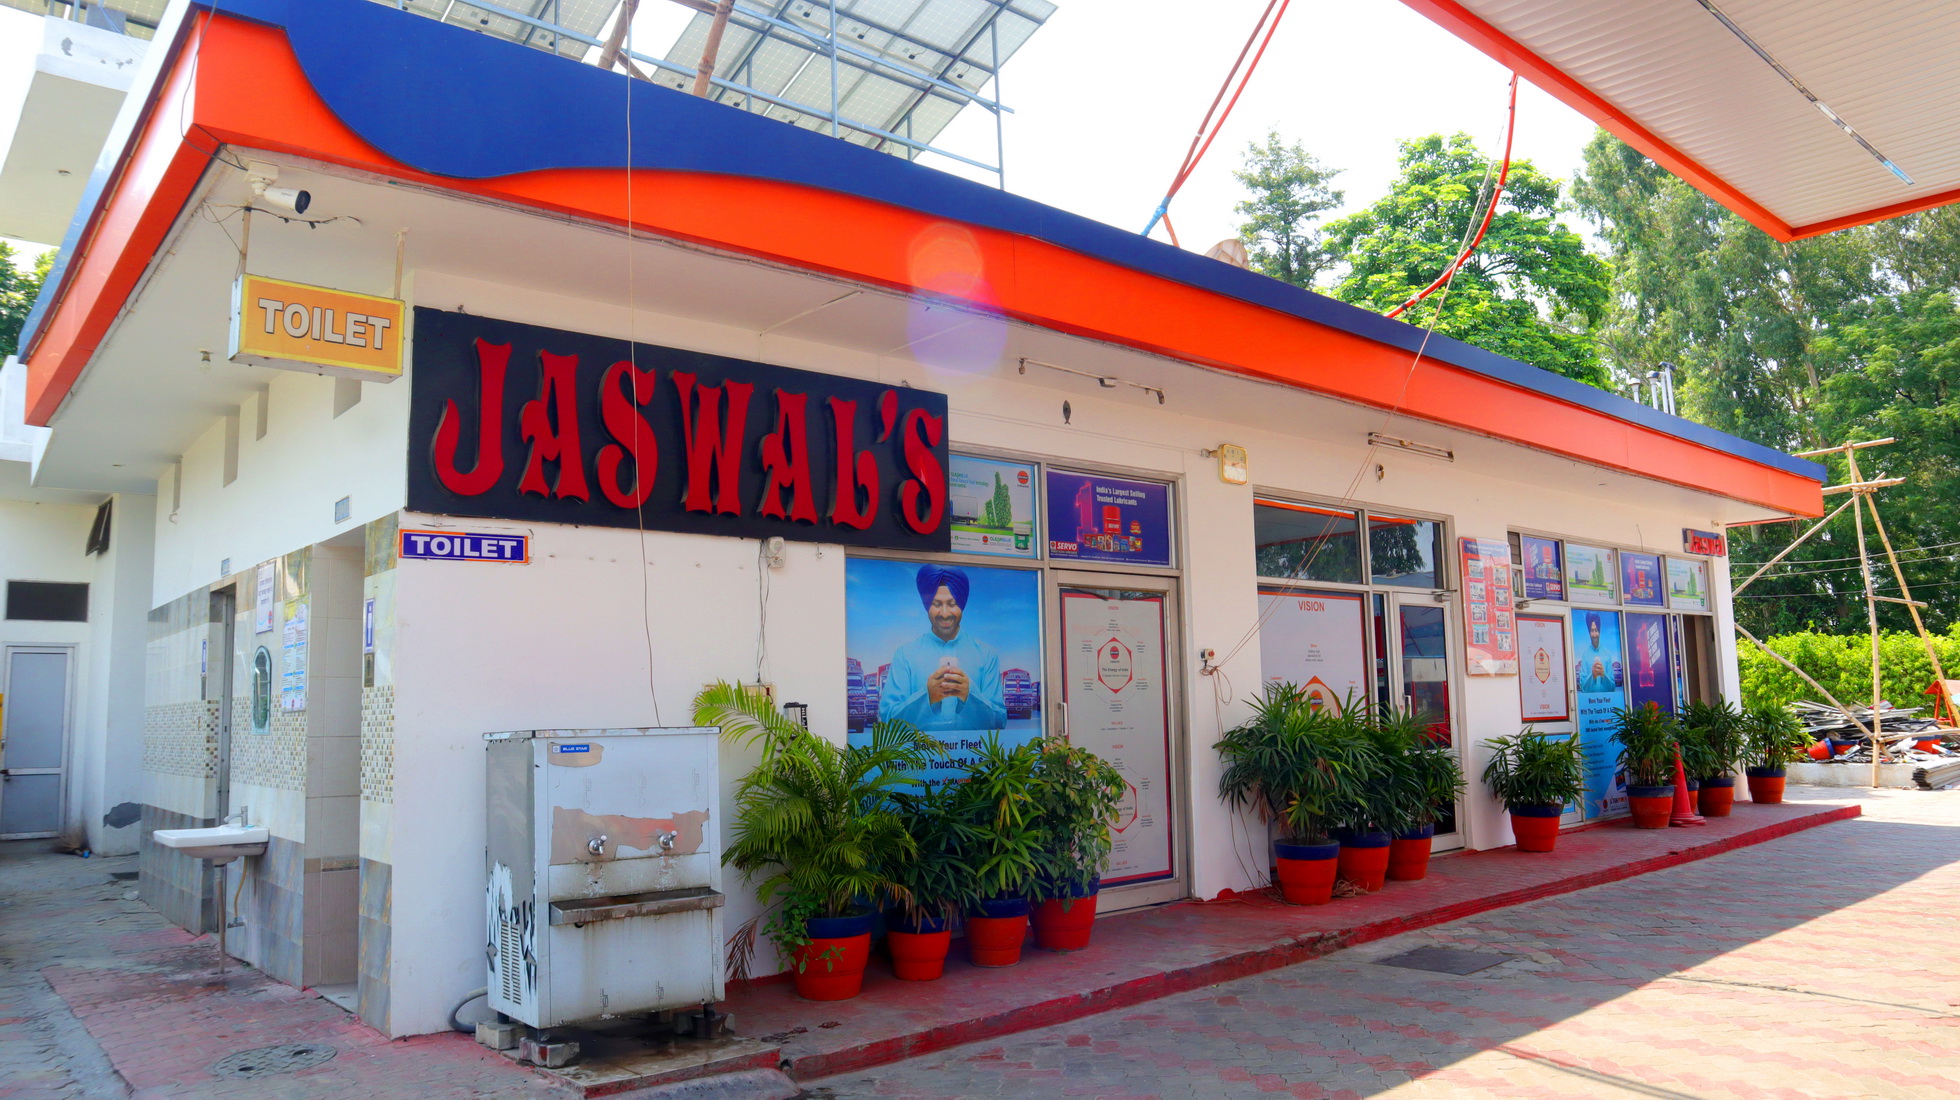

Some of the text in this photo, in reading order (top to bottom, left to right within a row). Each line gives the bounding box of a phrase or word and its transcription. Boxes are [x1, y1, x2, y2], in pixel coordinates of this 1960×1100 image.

[258, 297, 391, 351] TOILET
[431, 336, 946, 535] JASWAL'S
[410, 534, 524, 559] TOILET
[1057, 542, 1078, 551] SERVO
[1297, 600, 1325, 612] VISION
[960, 739, 982, 750] Fleet
[929, 758, 955, 770] Touch
[957, 757, 968, 768] Of
[929, 778, 940, 787] the
